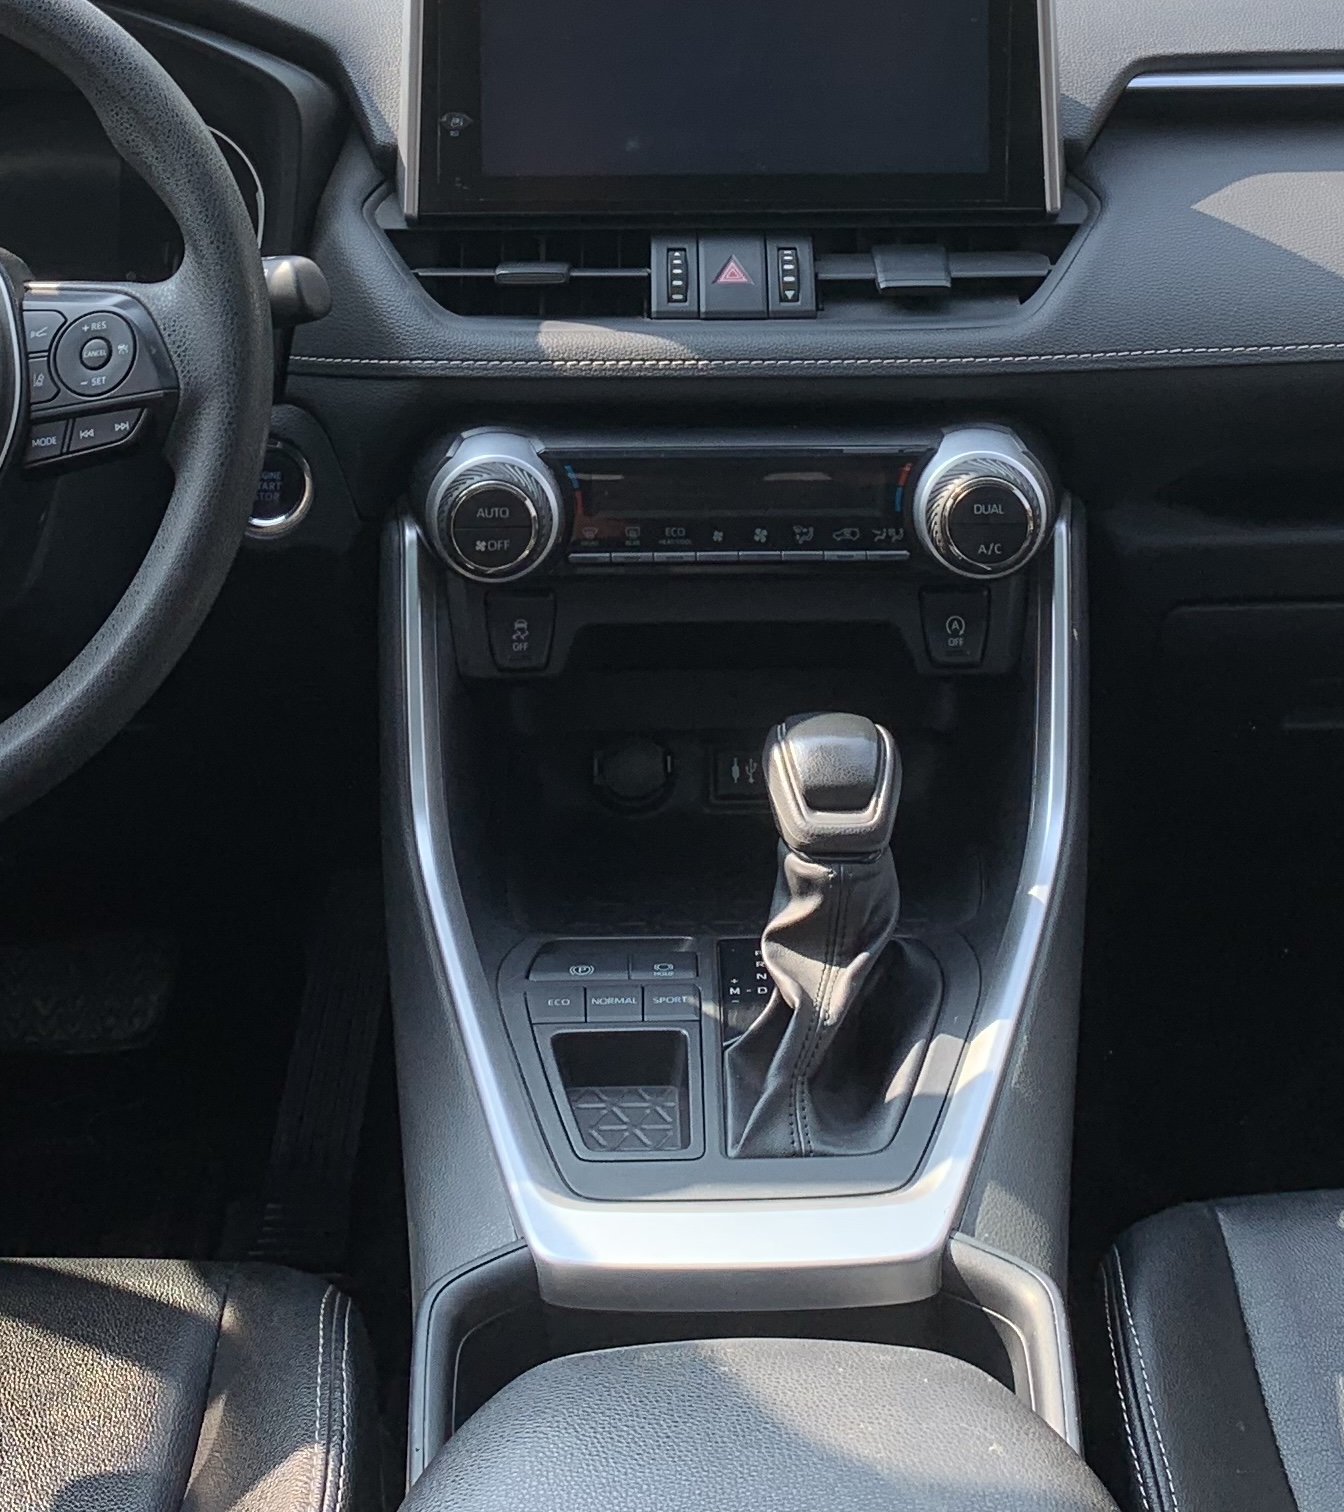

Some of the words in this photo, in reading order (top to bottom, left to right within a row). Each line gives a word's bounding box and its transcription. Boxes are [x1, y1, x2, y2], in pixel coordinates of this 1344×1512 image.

[91, 321, 107, 330] RES
[83, 349, 107, 358] CANCEL
[91, 376, 106, 386] SET
[32, 436, 57, 447] MODE
[476, 507, 510, 518] AUTO
[973, 503, 1004, 515] DUAL
[665, 527, 686, 537] ECO
[487, 540, 510, 551] OFF
[977, 543, 1002, 555] A/C
[512, 641, 529, 652] OFF
[948, 637, 964, 647] OFF
[756, 972, 768, 980] N
[729, 986, 741, 995] M
[757, 986, 768, 995] D
[547, 998, 571, 1007] ECO
[591, 997, 638, 1006] NORMAL
[653, 995, 687, 1004] SPORT
